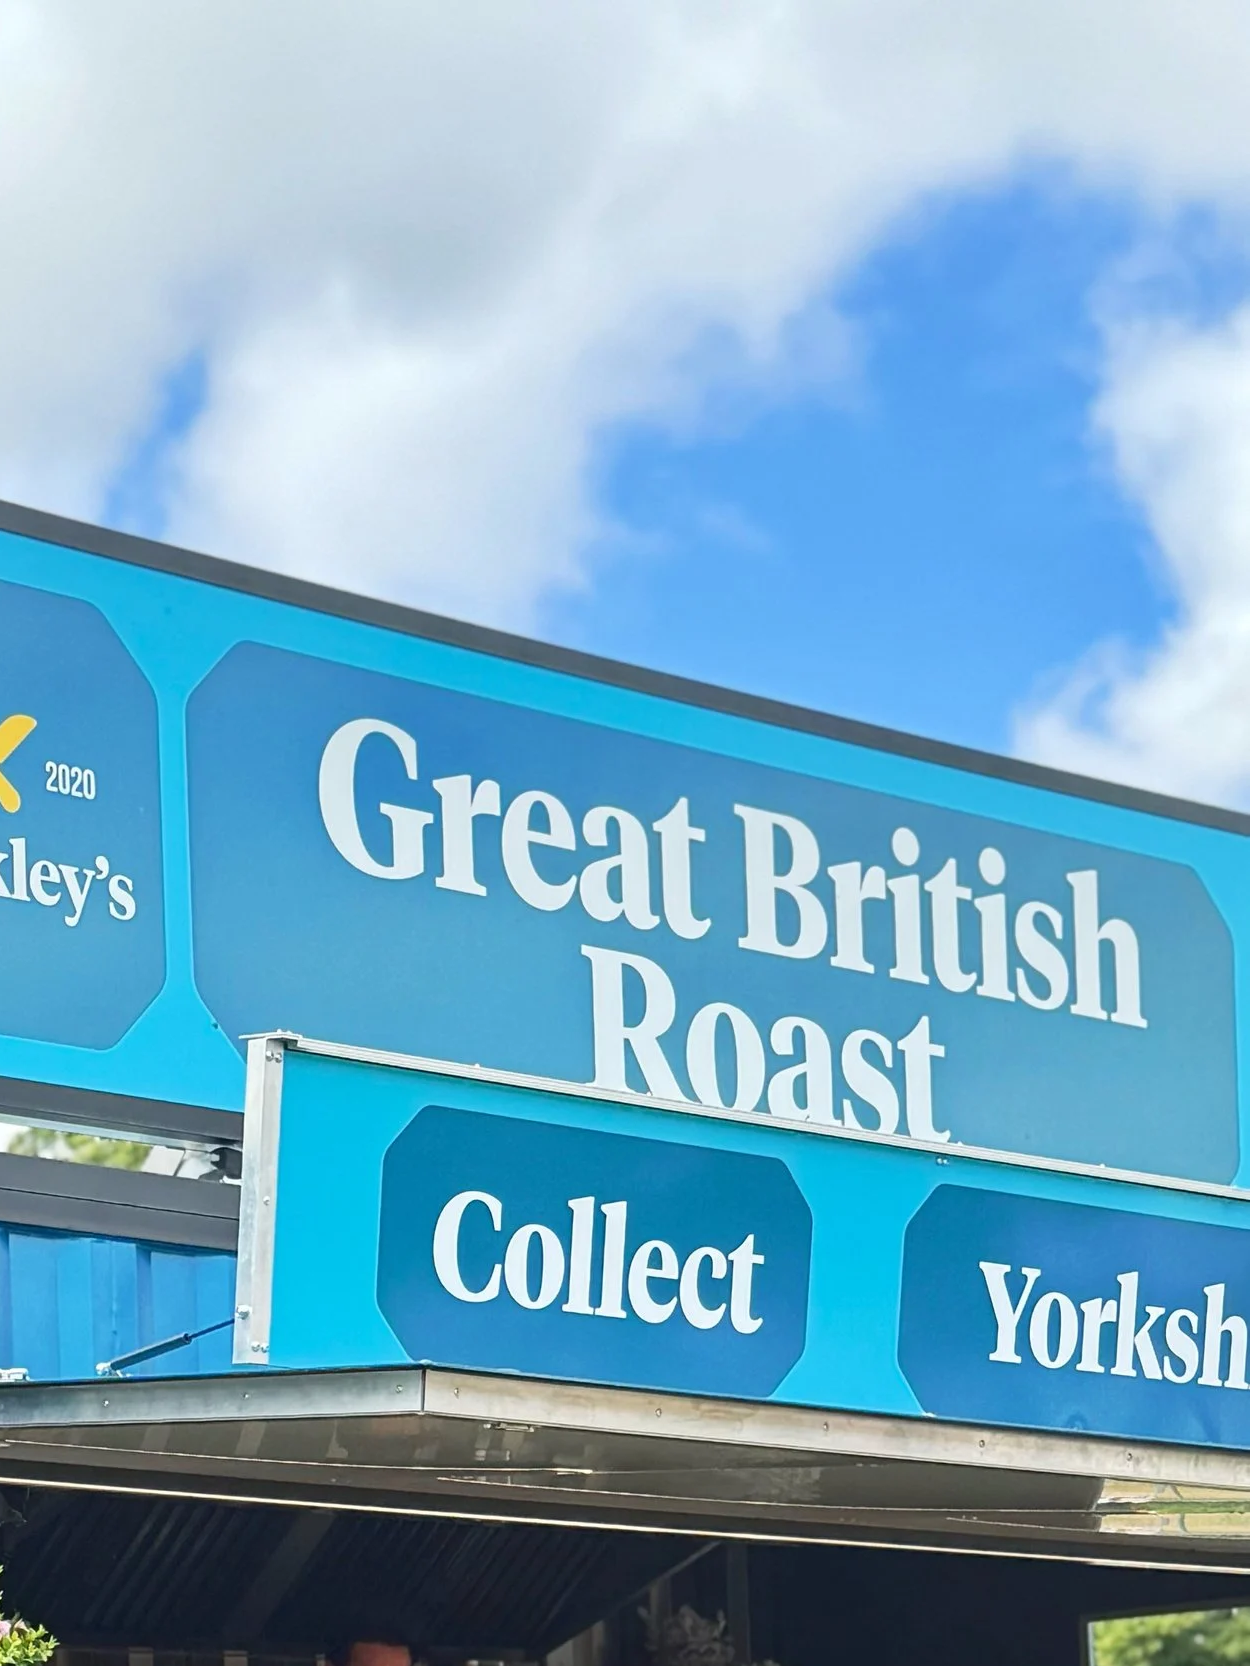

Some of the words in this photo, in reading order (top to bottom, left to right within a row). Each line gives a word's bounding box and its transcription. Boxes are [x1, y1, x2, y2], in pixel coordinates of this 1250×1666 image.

[45, 760, 97, 800] 2020
[318, 717, 711, 940] Great
[733, 803, 1148, 1029] British
[581, 944, 951, 1144] Roast
[432, 1190, 765, 1335] Collect
[979, 1260, 1250, 1390] Yorksh
